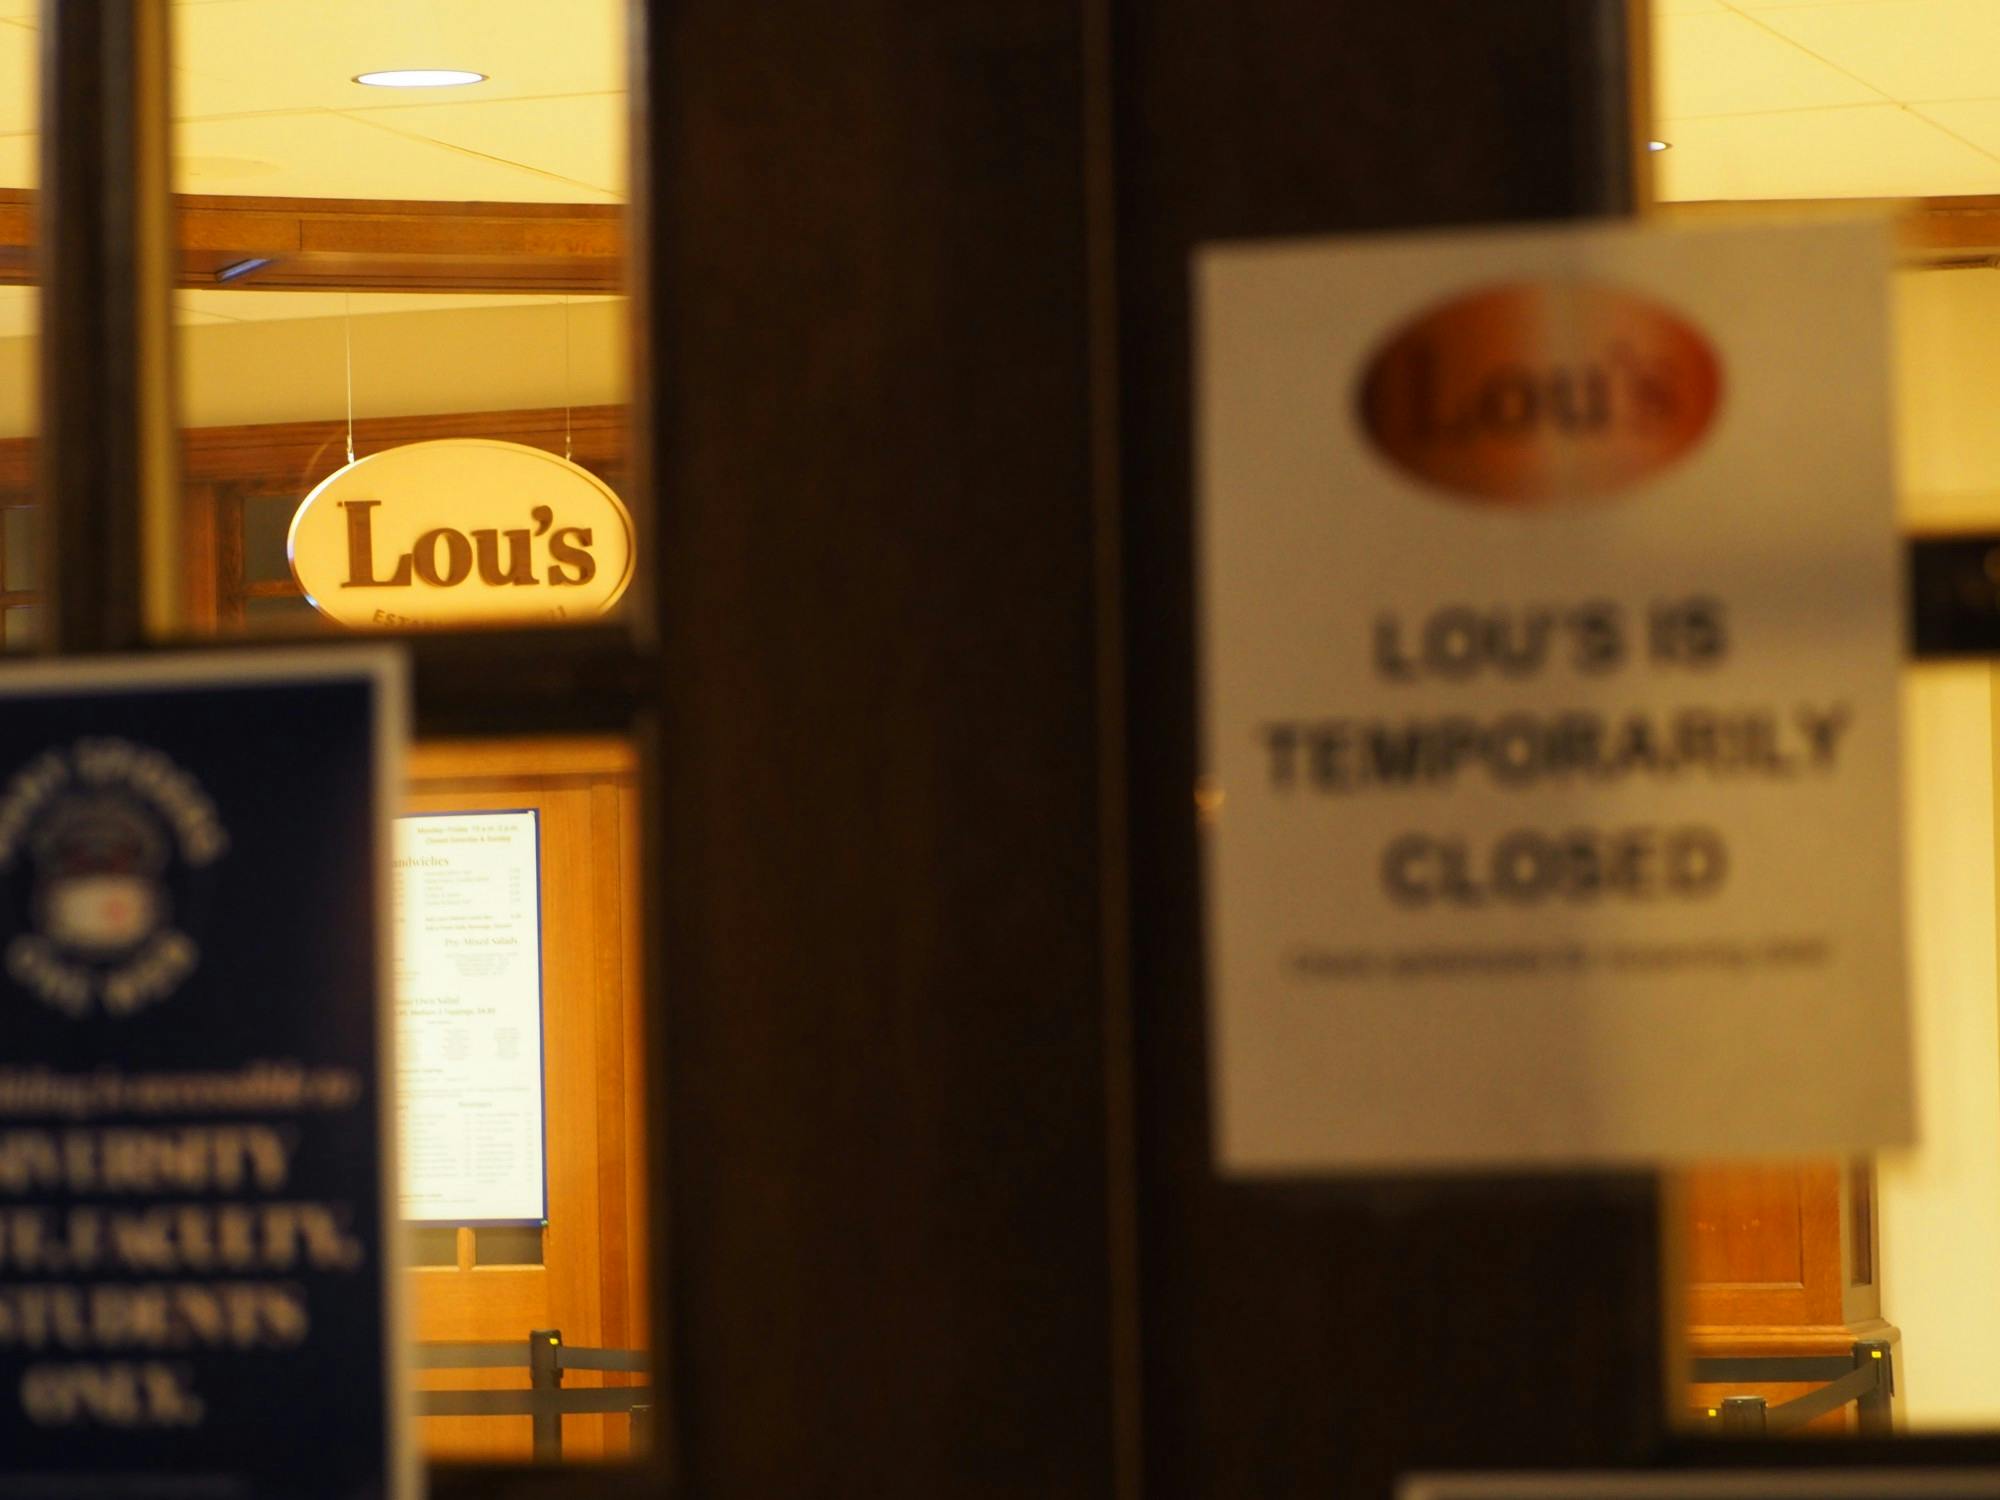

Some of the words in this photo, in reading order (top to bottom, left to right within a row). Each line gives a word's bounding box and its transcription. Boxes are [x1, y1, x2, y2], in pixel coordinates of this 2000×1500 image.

[337, 500, 596, 588] Lou's
[1373, 597, 1627, 684] LOU'S
[1645, 594, 1729, 676] IS
[1256, 701, 1853, 798] TEMPORARILY
[1380, 823, 1730, 911] CLOSED
